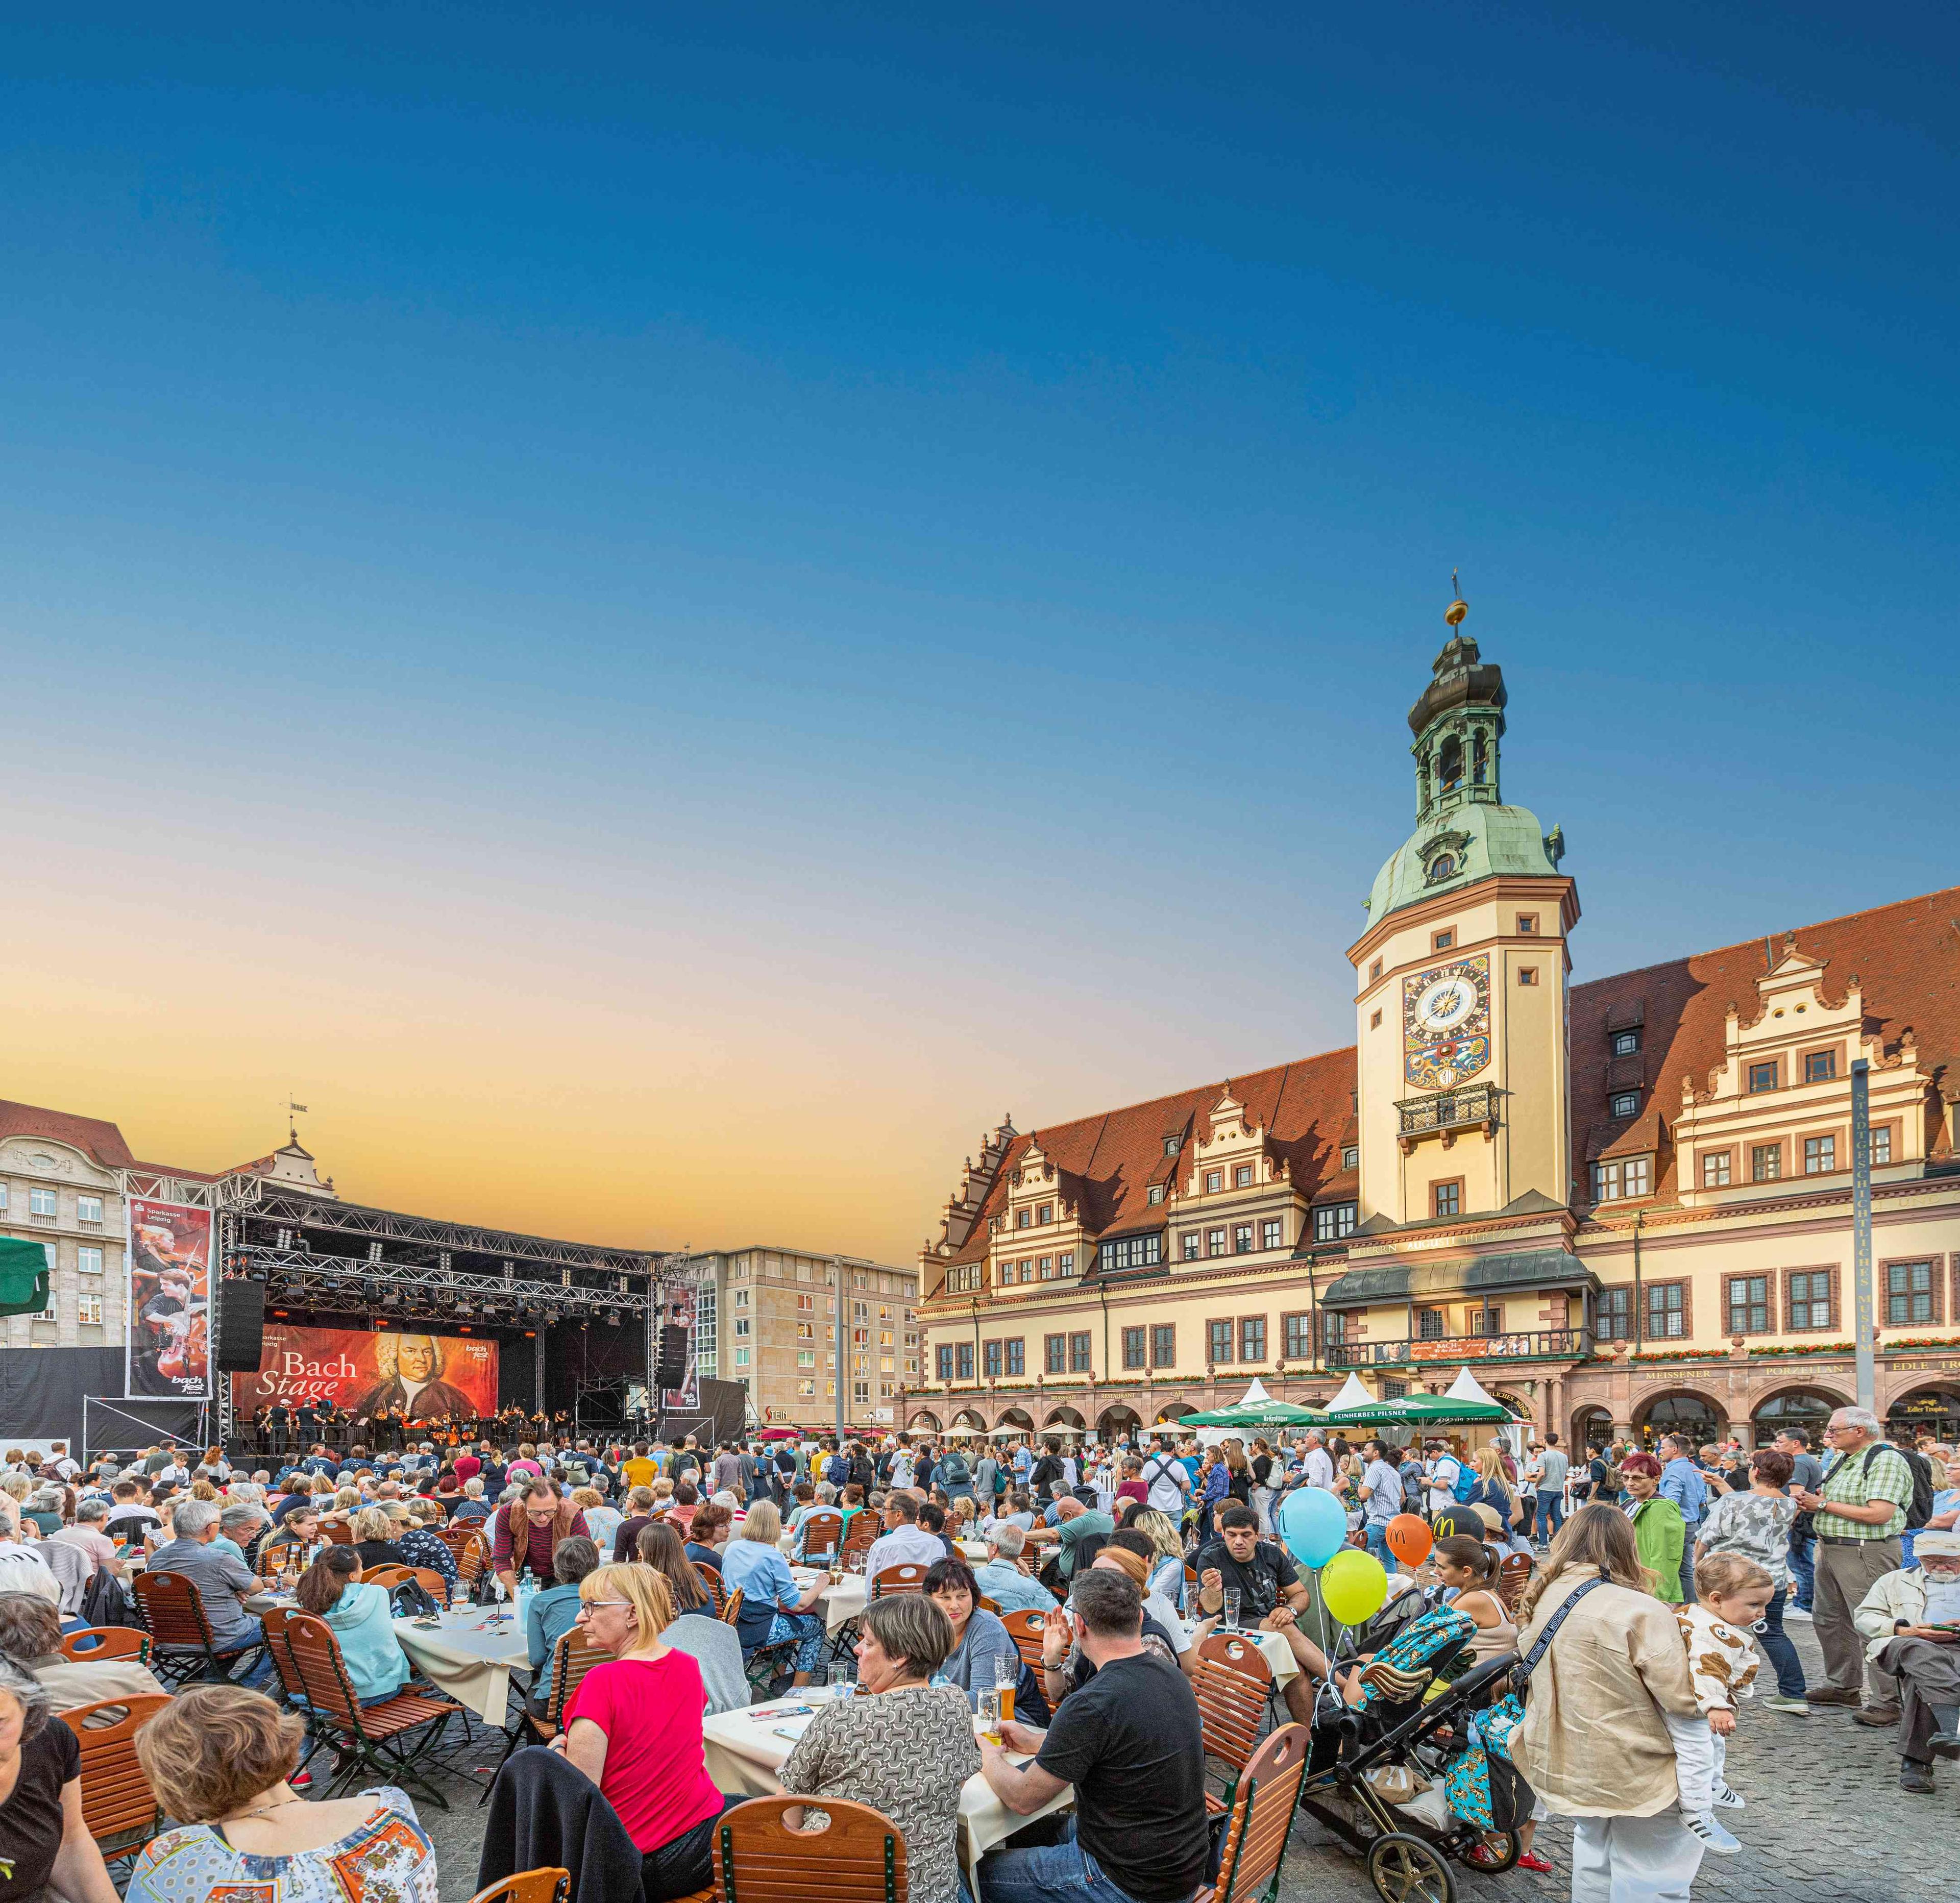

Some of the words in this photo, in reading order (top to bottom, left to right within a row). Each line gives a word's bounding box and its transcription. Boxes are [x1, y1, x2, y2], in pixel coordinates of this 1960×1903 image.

[147, 1208, 181, 1218] Sparkasse
[147, 1215, 171, 1224] Leipzig
[1407, 1237, 1455, 1250] AUGUSTI
[1858, 1295, 1872, 1352] MUSEUM
[473, 1351, 489, 1360] fest
[282, 1352, 358, 1377] Bach
[1893, 1362, 1929, 1371] EDLE
[1646, 1370, 1711, 1379] MEISSENER
[1766, 1365, 1843, 1375] PORZELLAN
[172, 1375, 202, 1384] bach
[181, 1383, 204, 1393] fest
[256, 1371, 338, 1404] Stage
[1529, 1641, 1545, 1664] MOSCHINO
[1542, 1628, 1553, 1642] LOVE
[1549, 1607, 1567, 1631] MOSCHINO
[1566, 1594, 1578, 1607] LOVE
